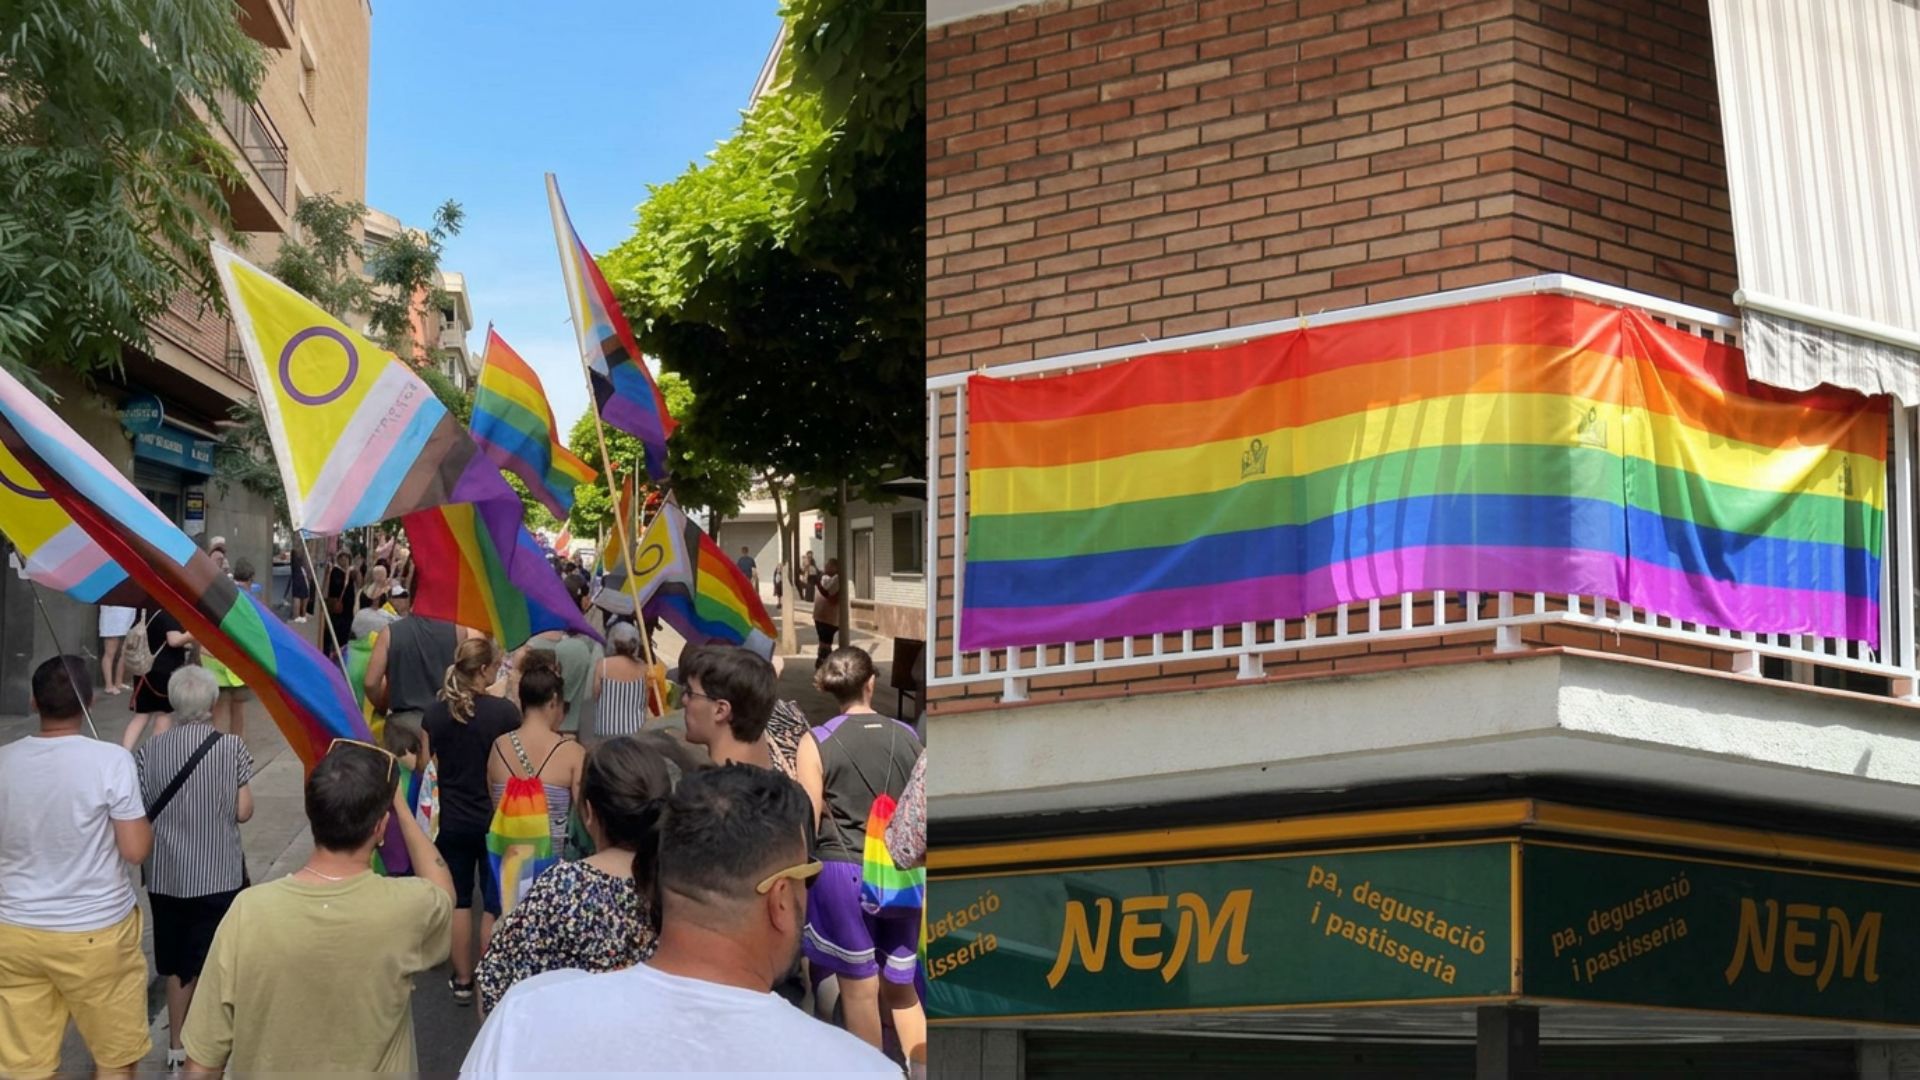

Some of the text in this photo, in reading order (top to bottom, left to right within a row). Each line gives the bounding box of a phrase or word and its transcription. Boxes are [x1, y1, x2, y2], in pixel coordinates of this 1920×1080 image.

[1046, 888, 1253, 989] NEM
[1307, 864, 1487, 955] pa, degustació
[1310, 901, 1457, 985] i pastisseria
[1551, 870, 1691, 957] pa, degustació
[1571, 916, 1689, 984] i pastisseria
[1724, 897, 1882, 993] NEM
